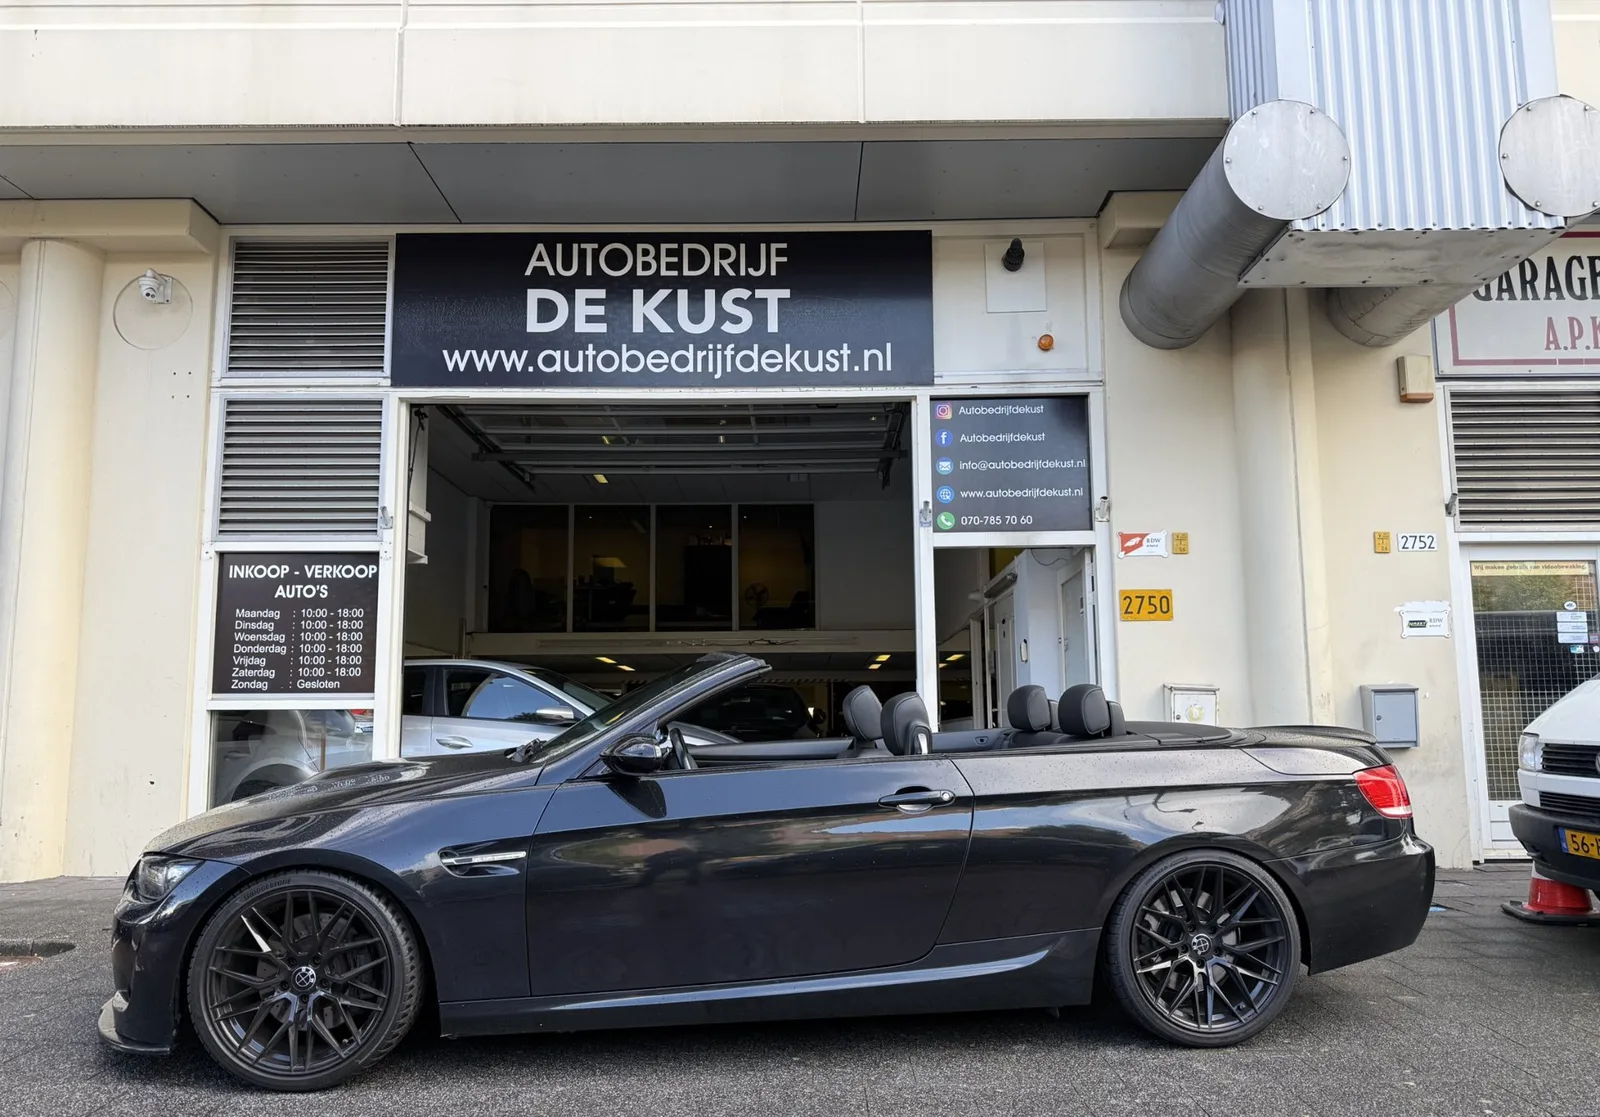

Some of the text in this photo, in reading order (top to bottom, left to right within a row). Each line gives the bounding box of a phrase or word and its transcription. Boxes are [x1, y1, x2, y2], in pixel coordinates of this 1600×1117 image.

[525, 243, 787, 276] AUTOBEDRIJF
[527, 288, 790, 334] DE KUST
[443, 343, 891, 379] www.autobedrijfdekust.nl
[959, 405, 1043, 415] Autobedrijfdekust
[960, 433, 1045, 443] Autobedrijfdekust
[960, 459, 1085, 470] info@autobedrijfdekust.nl
[960, 488, 1083, 498] www.autobedrijfdekust.nl
[961, 516, 1032, 525] 070-785 70 60
[1401, 535, 1435, 549] 2752
[229, 565, 289, 578] INKOOP
[305, 565, 377, 578] VERKOOP
[275, 585, 328, 598] AUTO'S
[1123, 596, 1170, 614] 2750
[236, 609, 280, 619] Maandag
[302, 609, 327, 617] 10:00
[338, 609, 363, 617] 18:00
[235, 621, 274, 631] Dinsdag
[301, 621, 327, 629] 10:00
[337, 620, 363, 629] 18:00
[235, 632, 285, 643] Woensdag
[300, 632, 326, 641] 10:00
[337, 632, 362, 641] 18:00
[234, 644, 286, 655] Donderdag
[300, 644, 325, 652] 10:00
[336, 644, 362, 652] 18:00
[233, 656, 266, 667] Vrijdag
[299, 656, 325, 664] 10:00
[336, 656, 361, 664] 18:00
[232, 668, 275, 678] Zaterdag
[299, 668, 324, 676] 10:00
[335, 668, 361, 676] 18:00
[231, 680, 268, 690] Zondag
[297, 680, 340, 688] Gesloten
[1571, 834, 1600, 857] 56-
